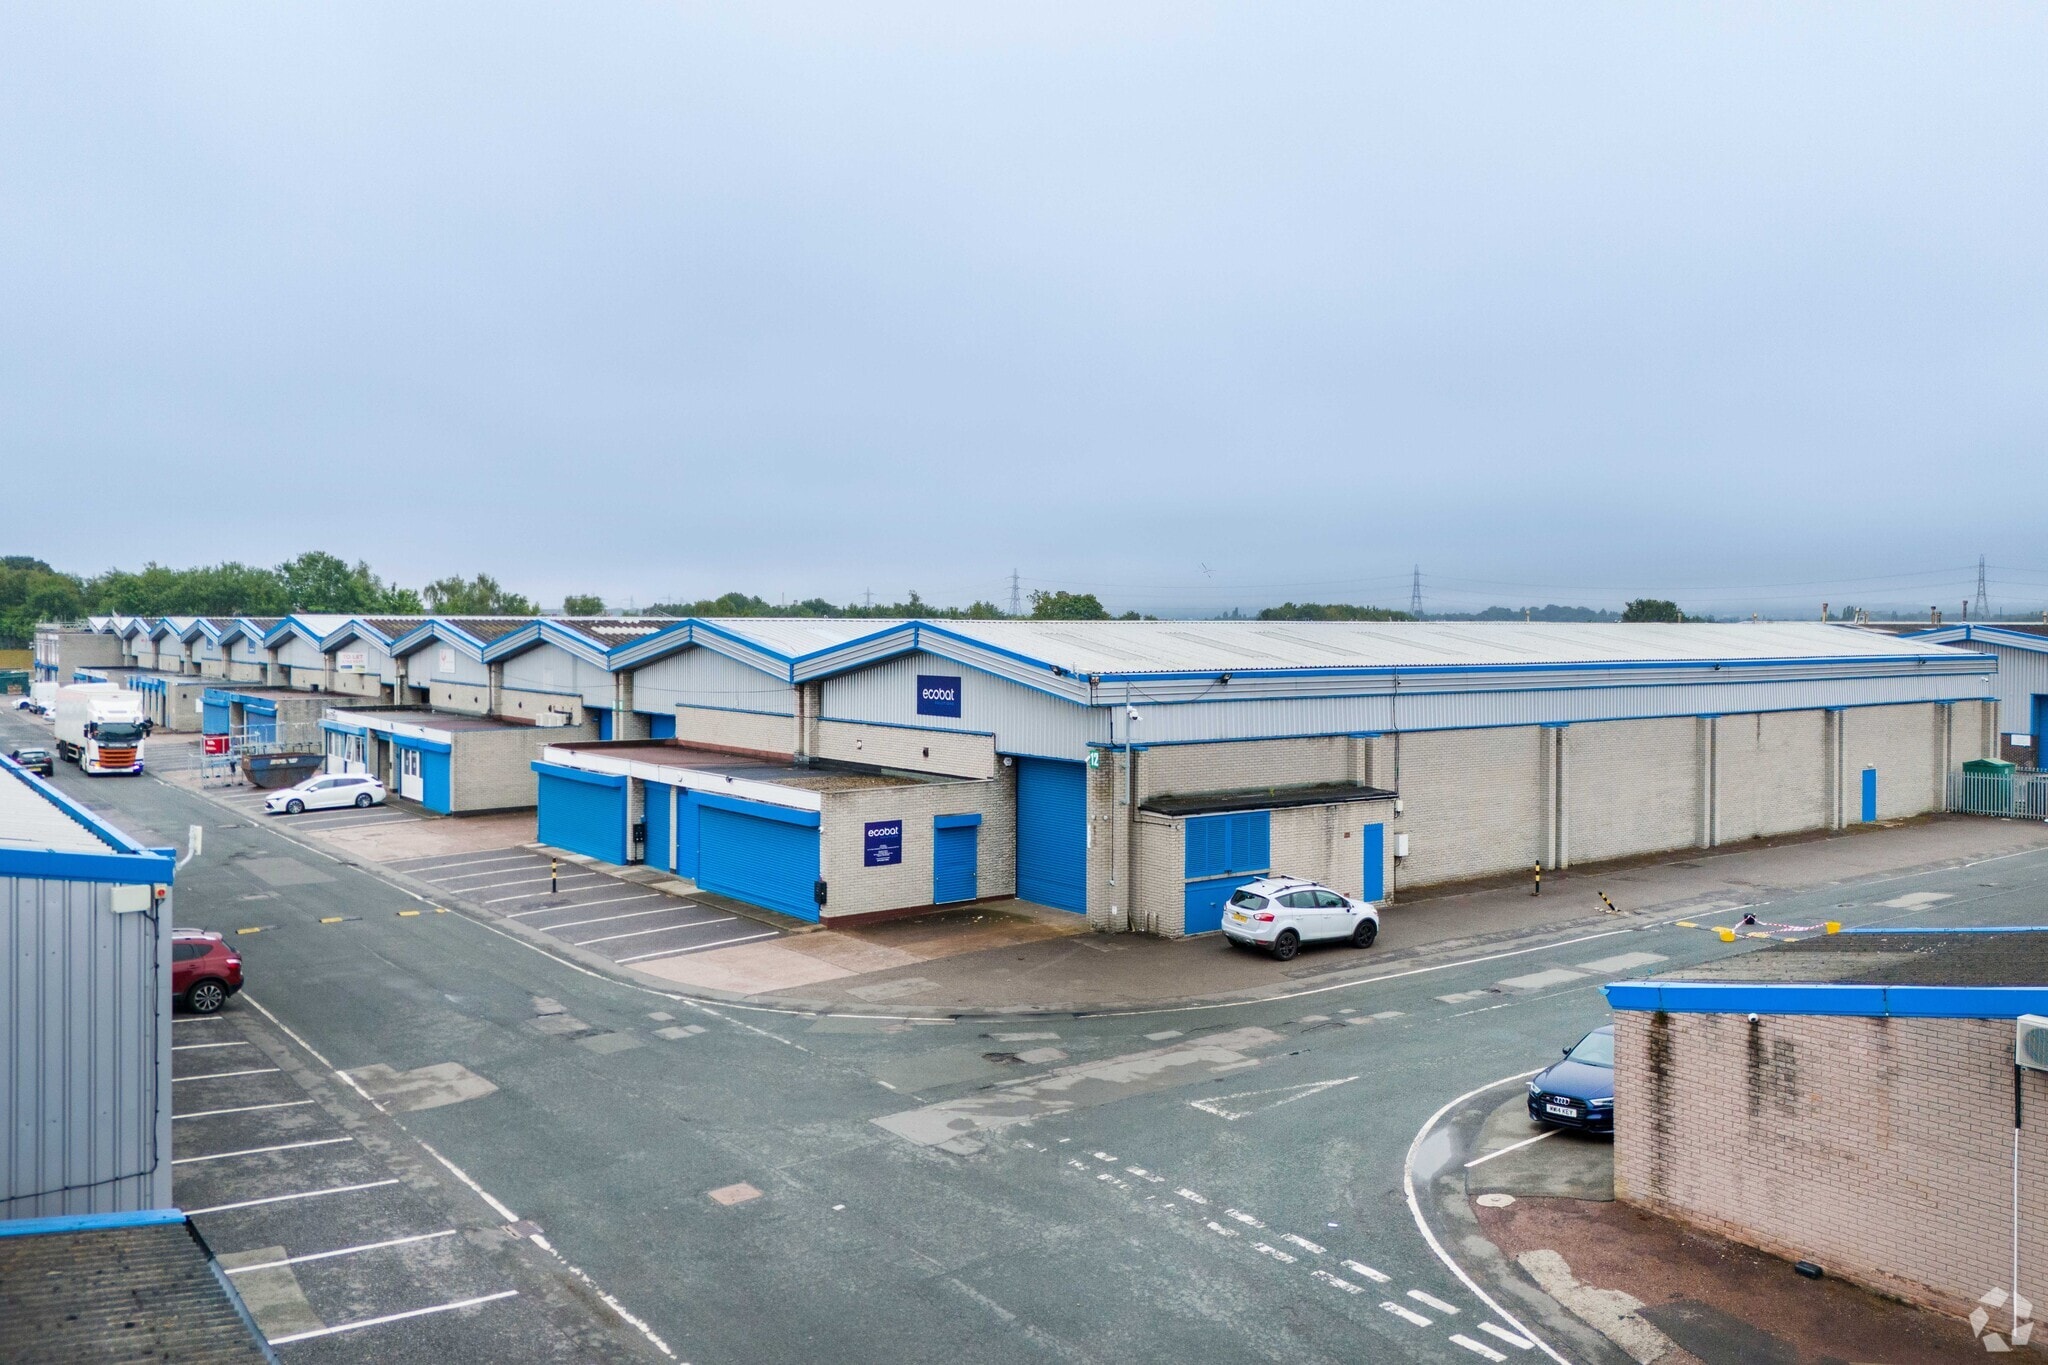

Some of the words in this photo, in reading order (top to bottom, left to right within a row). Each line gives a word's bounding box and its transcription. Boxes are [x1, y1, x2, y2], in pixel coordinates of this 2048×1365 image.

[922, 688, 954, 701] ecobat
[1090, 751, 1099, 767] 12
[868, 827, 898, 837] ecobat
